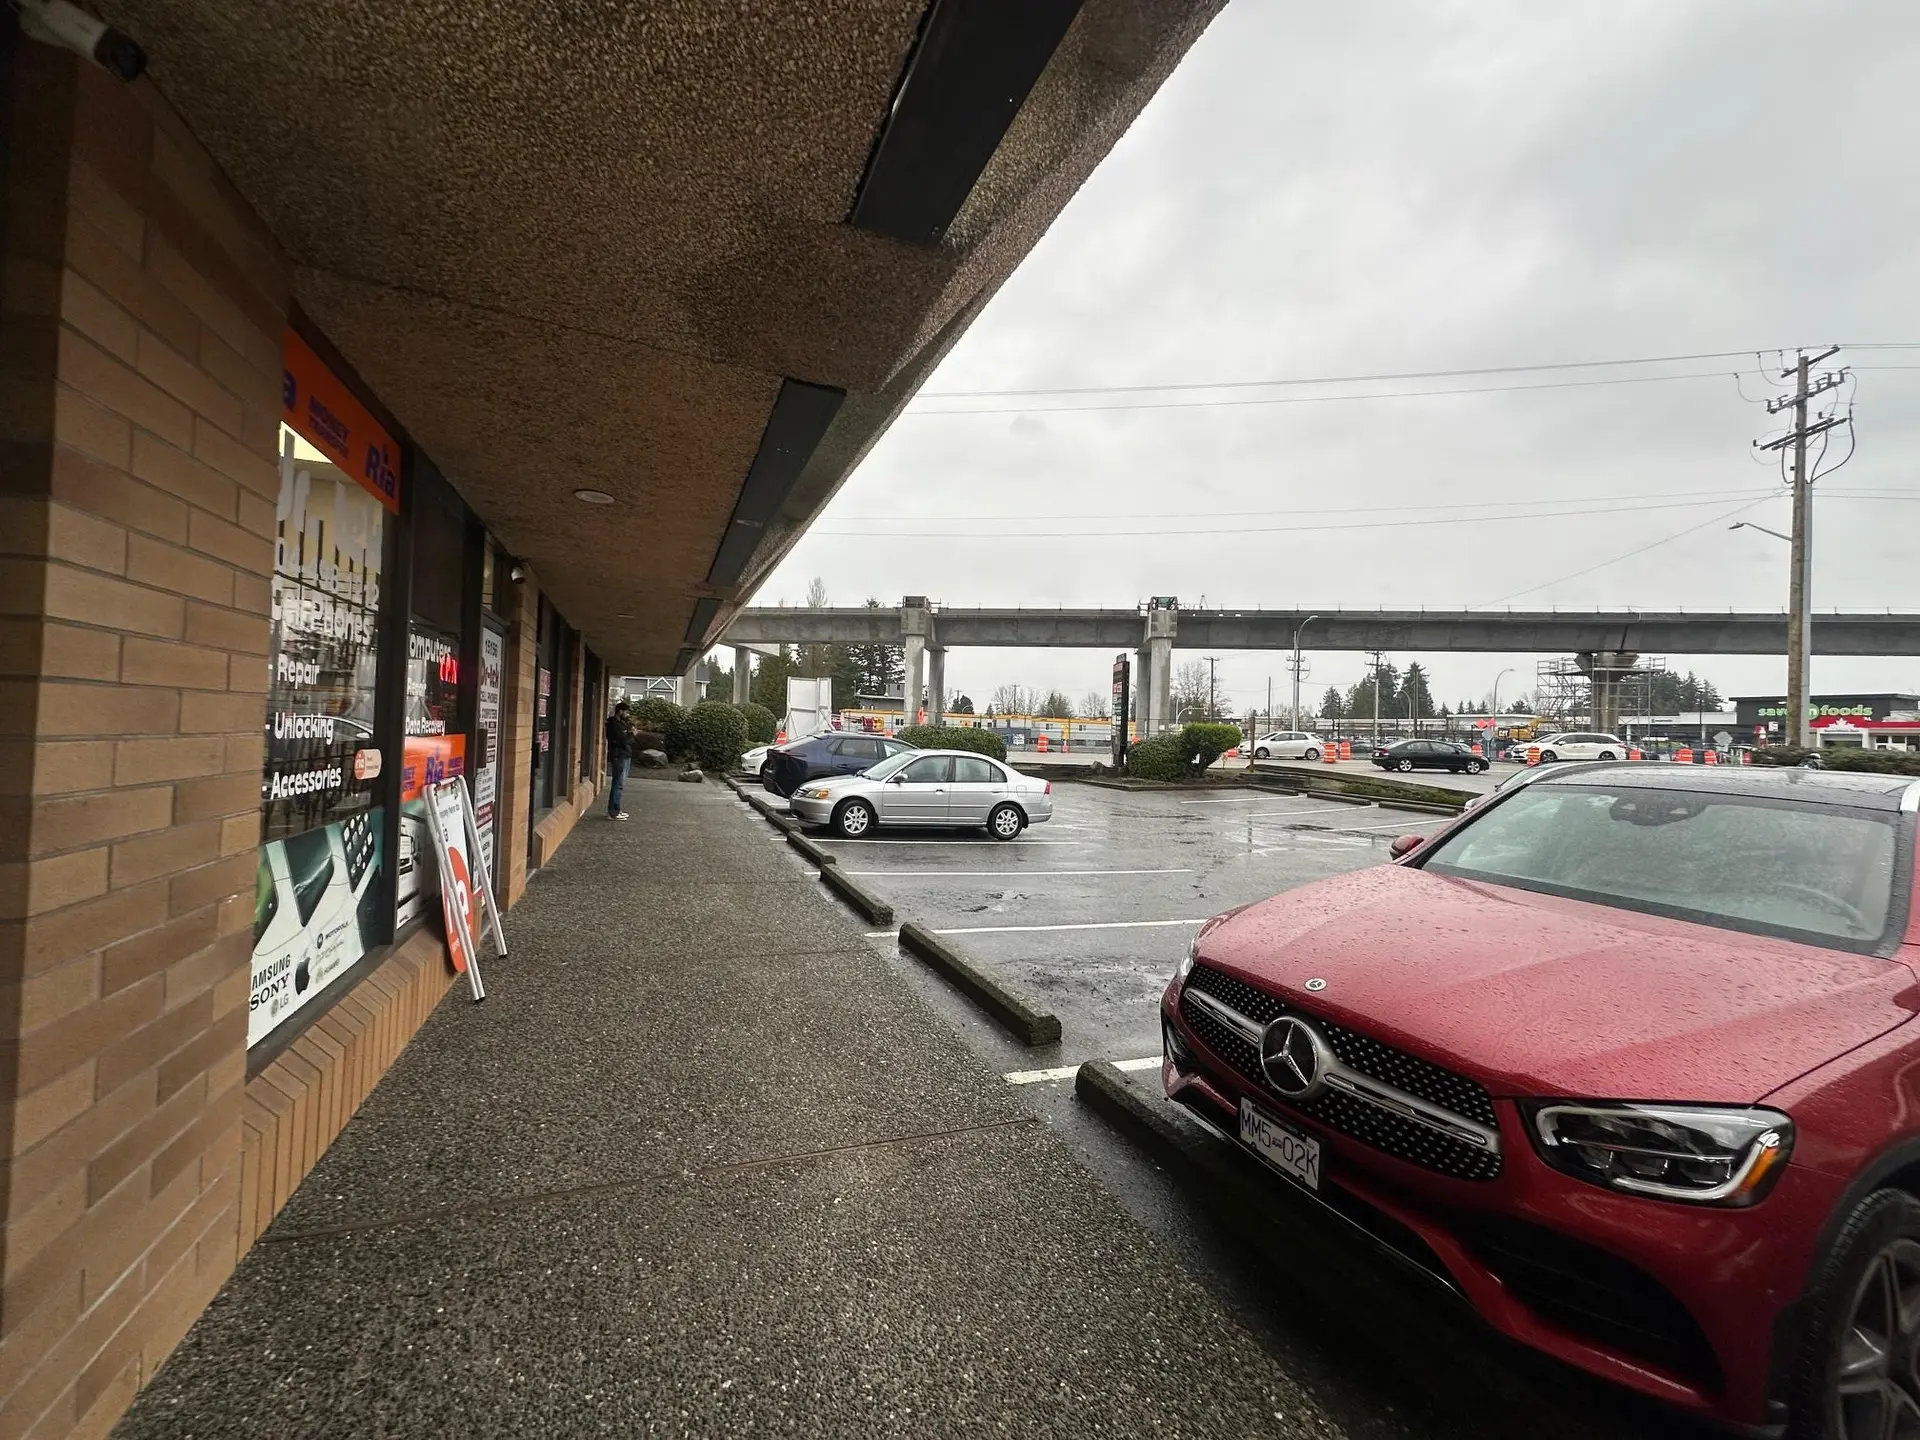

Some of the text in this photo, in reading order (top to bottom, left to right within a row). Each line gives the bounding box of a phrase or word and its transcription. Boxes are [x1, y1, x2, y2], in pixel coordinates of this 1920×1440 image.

[365, 442, 396, 499] Ria
[409, 634, 451, 664] omputers
[277, 653, 320, 689] Repair
[405, 716, 446, 736] Data Recovery
[1820, 704, 1873, 716] foods
[274, 712, 334, 745] Unlocking
[425, 746, 444, 785] Ria
[271, 766, 342, 799] Accessories
[251, 954, 291, 992] AMSUNG
[249, 973, 290, 1012] SONY
[279, 993, 289, 1009] LG
